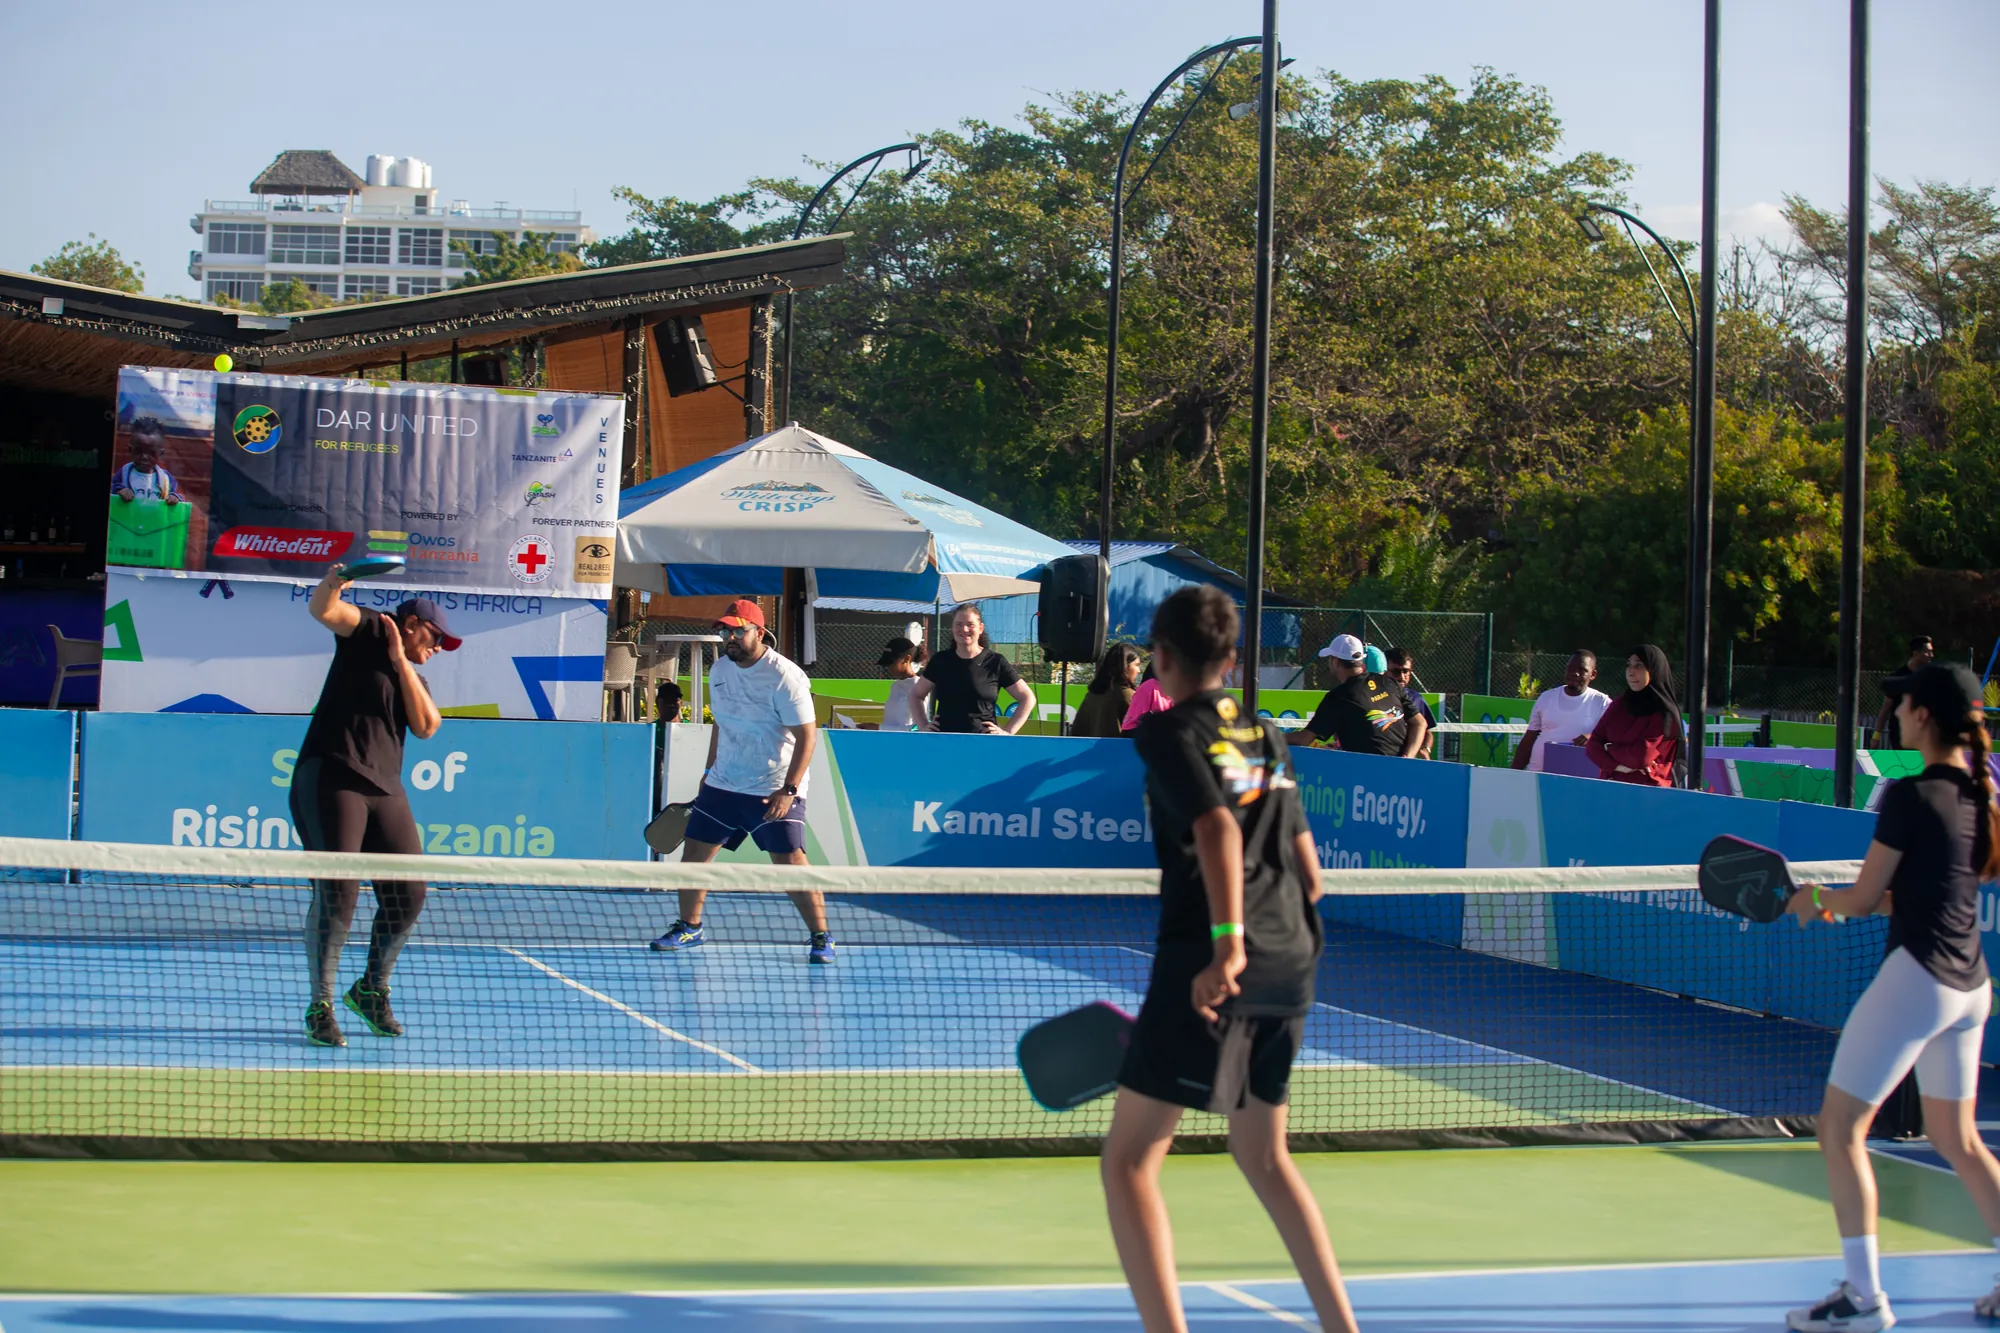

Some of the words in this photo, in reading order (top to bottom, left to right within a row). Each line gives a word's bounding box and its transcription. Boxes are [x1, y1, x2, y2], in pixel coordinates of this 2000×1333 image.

[316, 408, 372, 431] DAR
[380, 412, 479, 437] UNITED
[315, 440, 338, 450] FOR
[340, 441, 399, 454] REFUGEES
[512, 454, 557, 463] TANZANITE
[596, 417, 609, 504] VENUES
[401, 511, 445, 521] POWERED
[447, 513, 459, 521] BY
[738, 501, 814, 513] CRISP
[532, 518, 573, 527] FOREVER
[574, 520, 616, 528] PARTNERS
[233, 533, 333, 556] Whitedent
[516, 536, 548, 546] TANZANIA
[410, 546, 480, 562] Tanzania
[291, 584, 366, 605] PAEL
[465, 593, 543, 615] AFRICA
[1367, 679, 1377, 690] 9
[411, 751, 469, 793] of
[1296, 773, 1346, 828] ining
[1352, 785, 1426, 838] Energy,
[912, 800, 1042, 838] Kamal
[172, 804, 303, 849] Risin
[416, 814, 555, 856] zania
